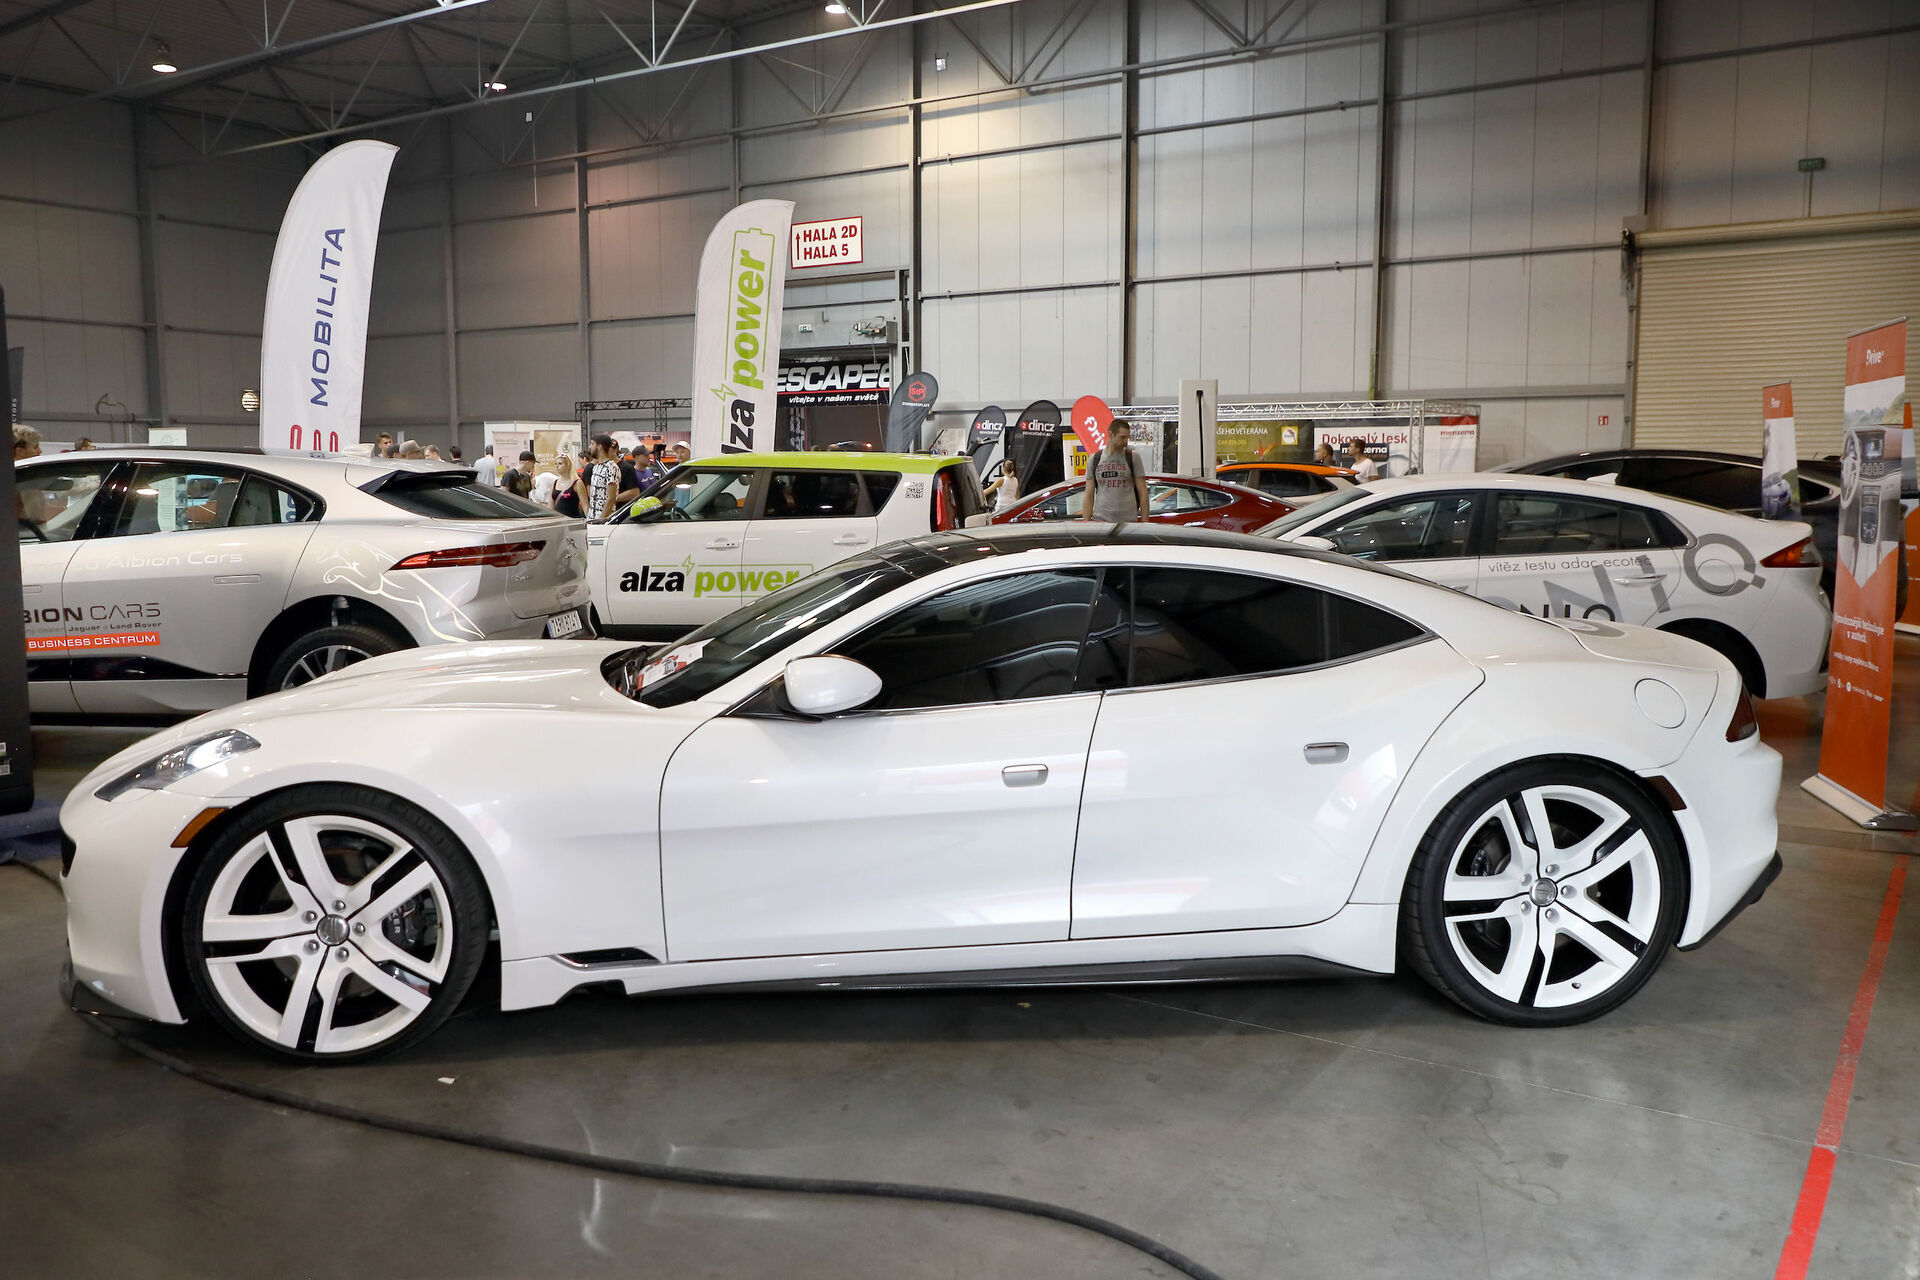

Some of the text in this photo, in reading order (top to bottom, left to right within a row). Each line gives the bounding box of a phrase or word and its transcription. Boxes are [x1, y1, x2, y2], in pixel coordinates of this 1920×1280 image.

[803, 224, 858, 243] HALA 2D
[803, 243, 849, 260] HALA 5
[310, 228, 346, 407] MOBILITA
[733, 248, 765, 390] power
[825, 394, 852, 403] našem
[854, 393, 879, 401] světě
[1028, 419, 1056, 432] dincz
[1216, 426, 1236, 435] ŠEHO
[1382, 433, 1408, 444] lesk
[106, 554, 181, 569] Albion
[187, 551, 244, 565] Cars
[1488, 561, 1521, 573] vítěz
[1525, 559, 1556, 571] testu
[1560, 556, 1598, 570] adac
[619, 565, 685, 593] alza
[693, 567, 801, 598] power
[89, 602, 162, 621] CARS
[68, 624, 101, 632] Jaguar
[110, 622, 133, 630] Land
[134, 621, 163, 629] Rover
[28, 634, 157, 649] BUSINESS CENTRUM
